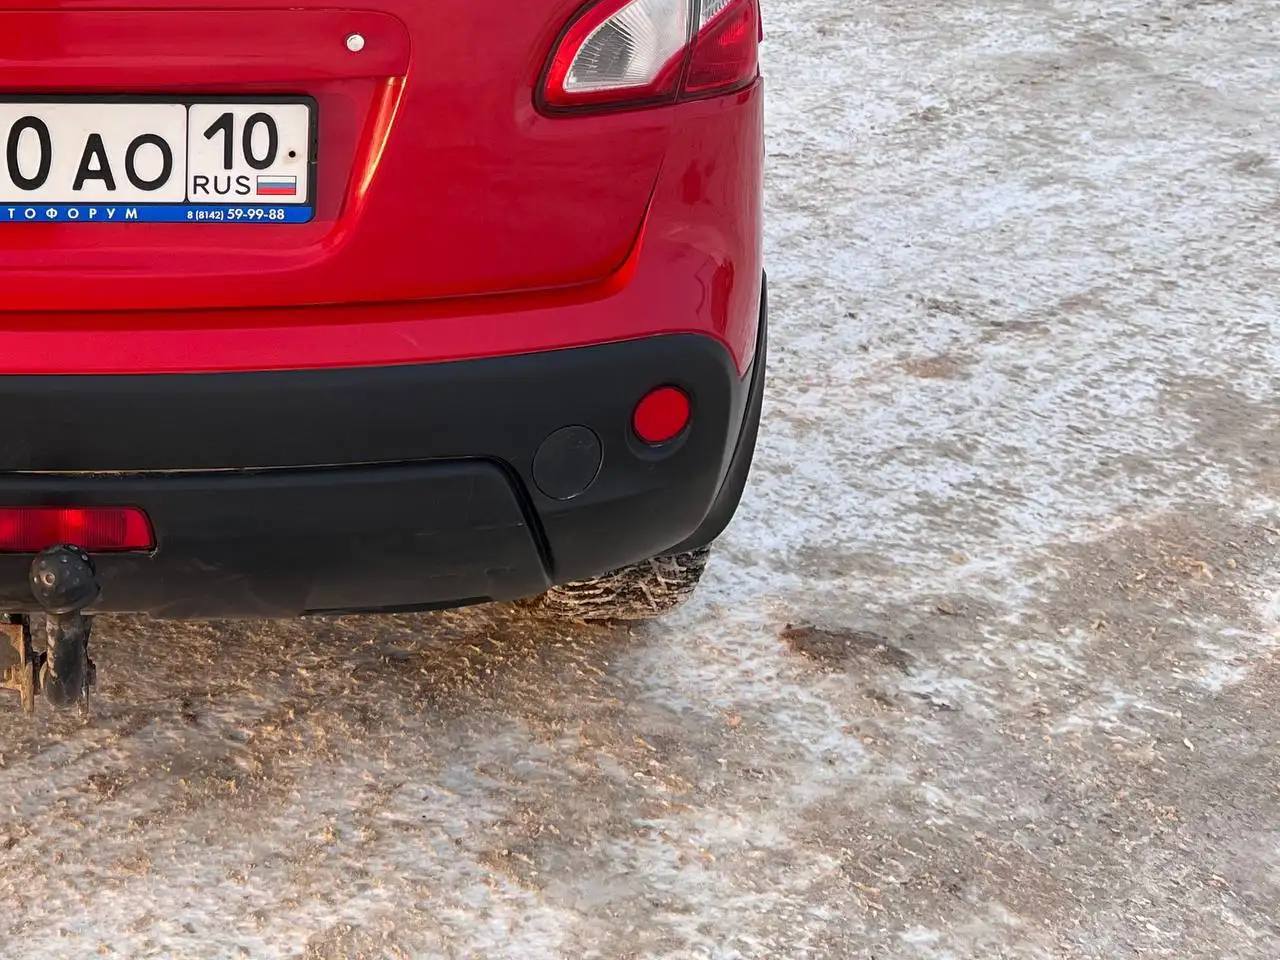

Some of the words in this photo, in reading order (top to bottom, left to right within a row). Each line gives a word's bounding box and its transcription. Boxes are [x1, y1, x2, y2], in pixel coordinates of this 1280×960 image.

[203, 112, 279, 170] 10
[193, 176, 251, 196] RUS
[187, 210, 193, 219] 8
[195, 210, 224, 221] (8142)
[227, 208, 285, 220] 59-99-88
